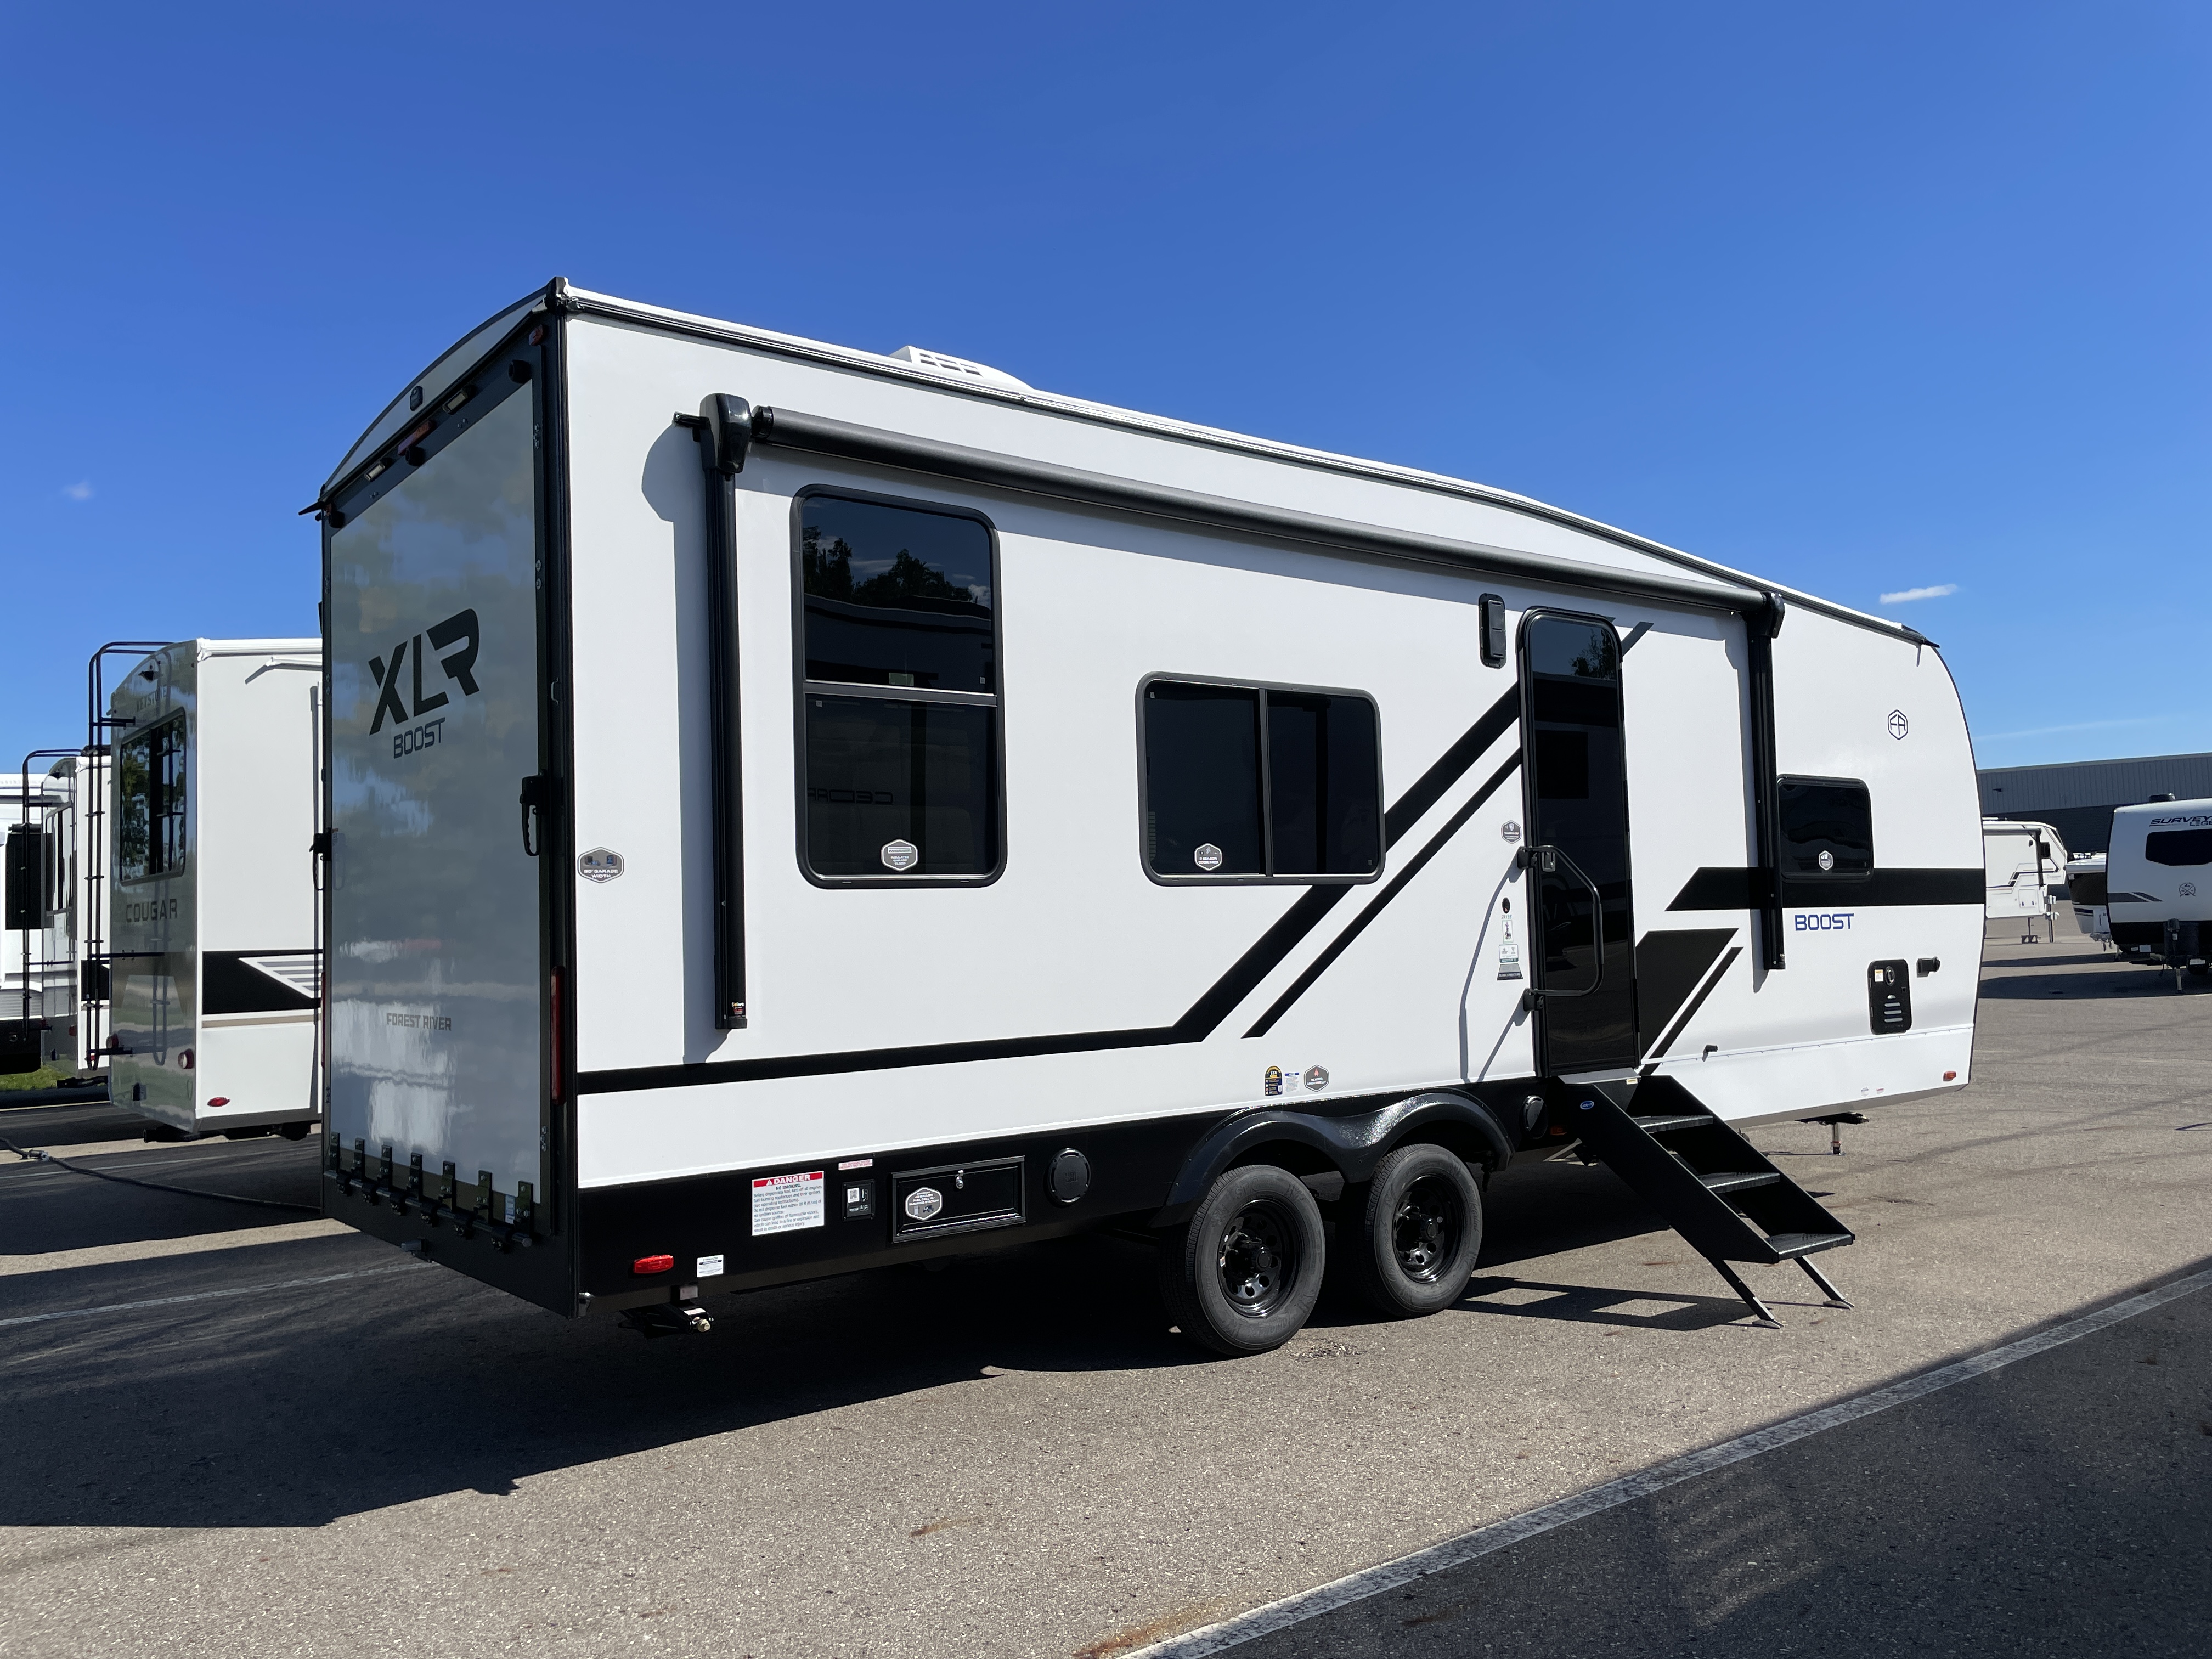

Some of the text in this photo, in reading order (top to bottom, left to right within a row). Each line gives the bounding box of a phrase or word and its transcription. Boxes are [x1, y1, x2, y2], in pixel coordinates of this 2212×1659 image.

[368, 608, 479, 736] XLR
[394, 717, 445, 759] BOOST
[126, 899, 177, 922] COUGAR
[1795, 913, 1854, 931] BOOST
[387, 1013, 452, 1031] FOREST RIVER
[774, 1174, 810, 1184] DANGER
